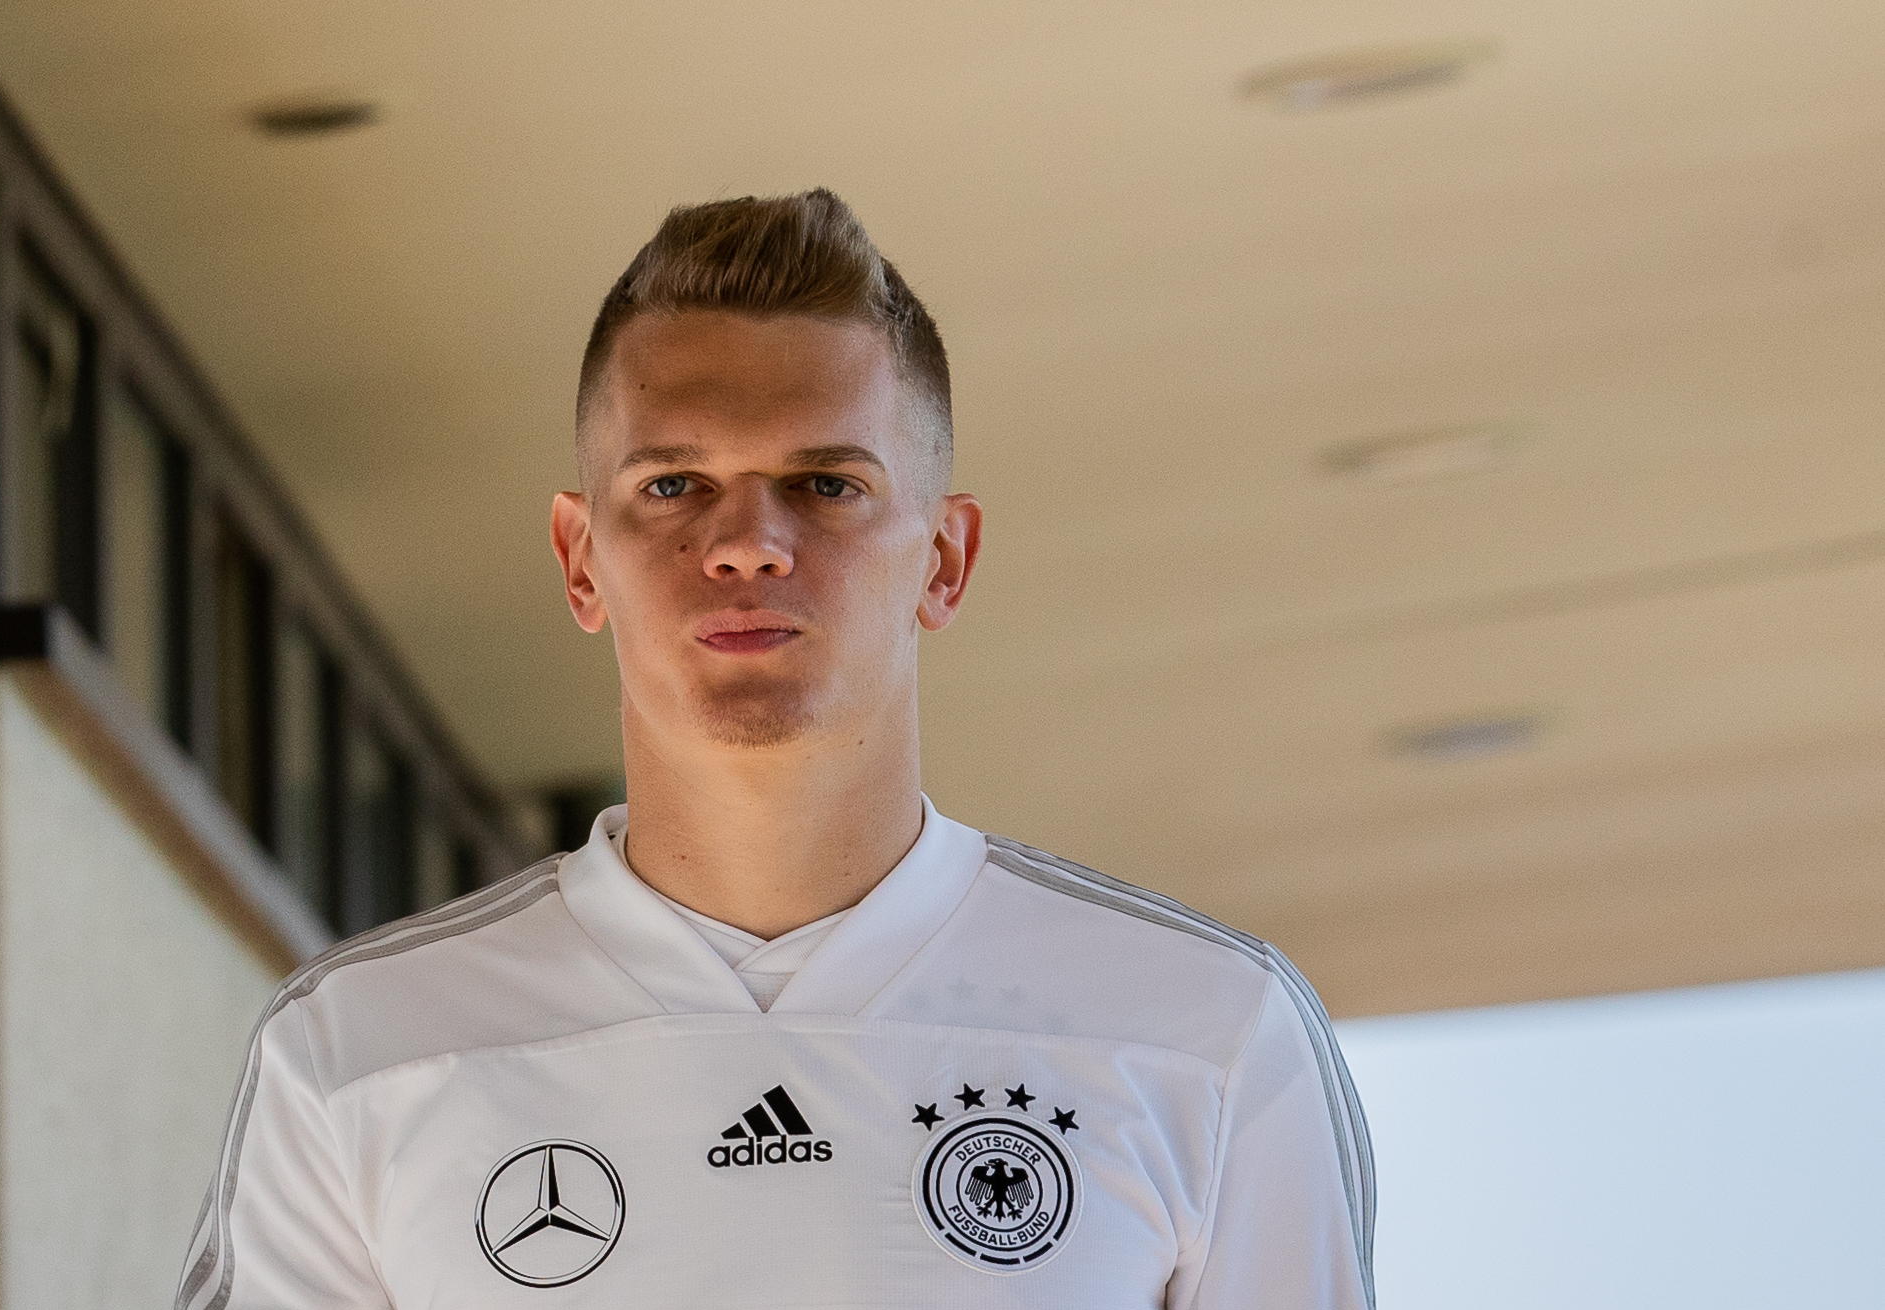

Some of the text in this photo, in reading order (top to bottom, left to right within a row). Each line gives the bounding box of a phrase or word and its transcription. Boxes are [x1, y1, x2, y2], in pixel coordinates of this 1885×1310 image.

[707, 1135, 833, 1168] adidas
[955, 1136, 1042, 1166] DEUTSCHER
[948, 1204, 1051, 1246] FUSSBALL-BUND
